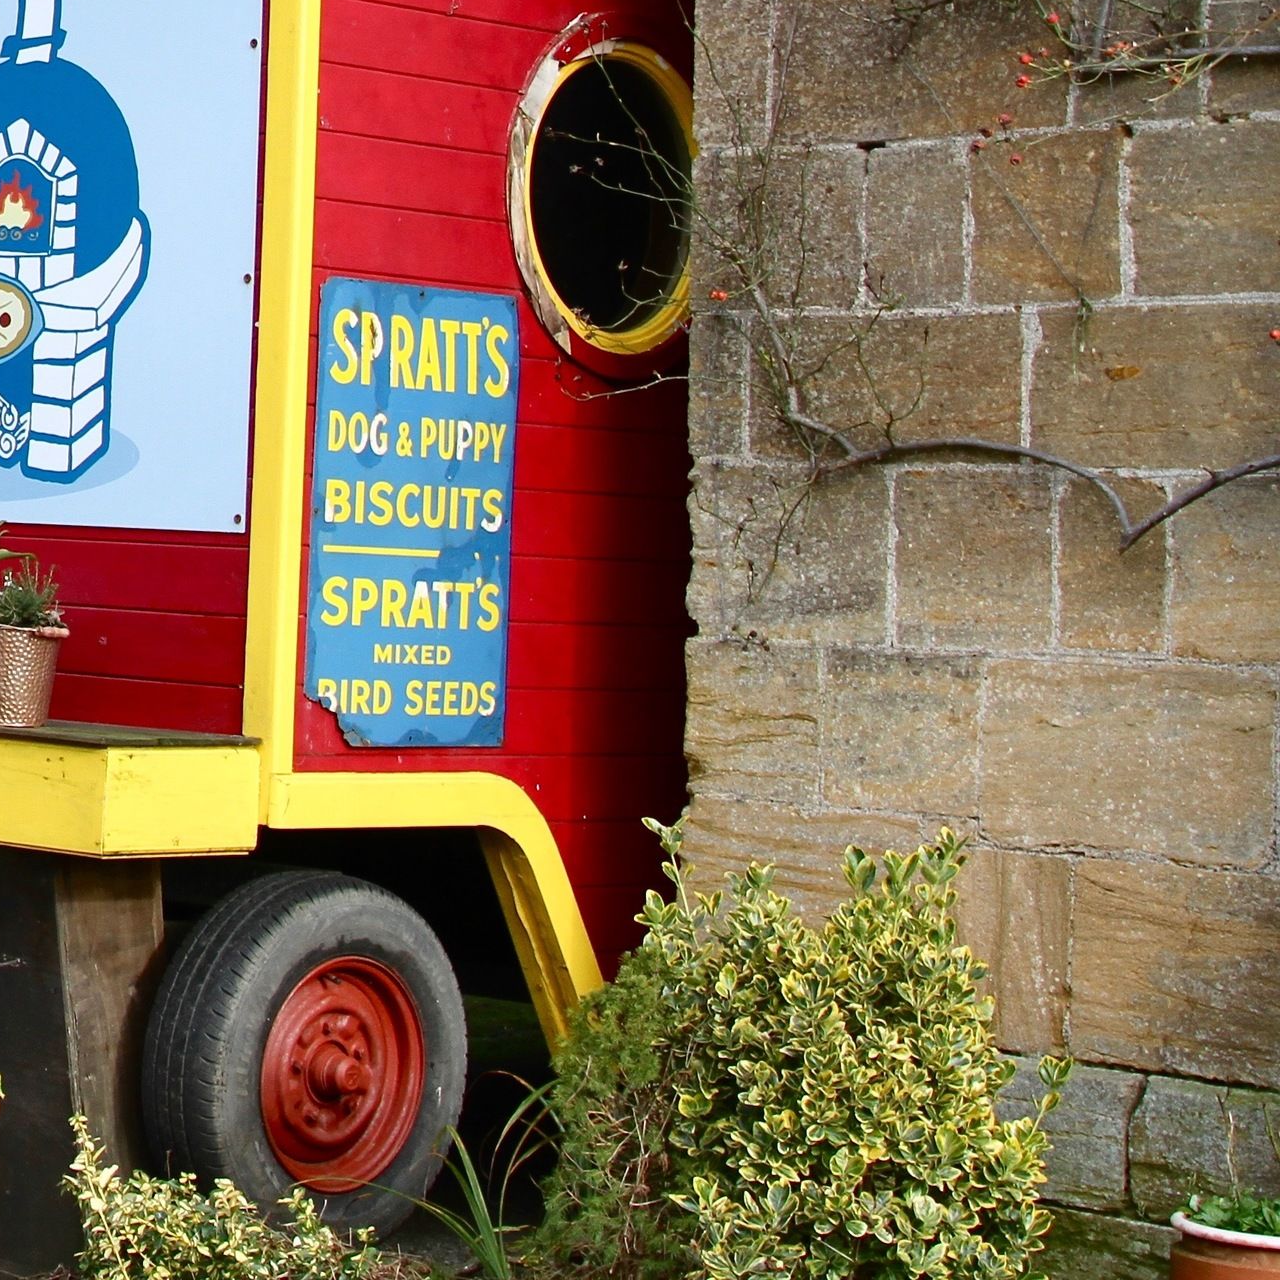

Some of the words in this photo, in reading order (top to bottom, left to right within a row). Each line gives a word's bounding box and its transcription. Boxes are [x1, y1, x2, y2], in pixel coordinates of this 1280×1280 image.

[329, 307, 509, 398] SPRATT'S
[327, 409, 388, 456] DOG
[396, 421, 413, 458] &
[420, 415, 507, 464] PUPPY
[324, 478, 504, 533] BISCUITS
[320, 575, 500, 632] SPRATT'S
[373, 643, 451, 665] MIXED
[317, 678, 393, 715] BIRD
[404, 680, 497, 717] SEEDS
